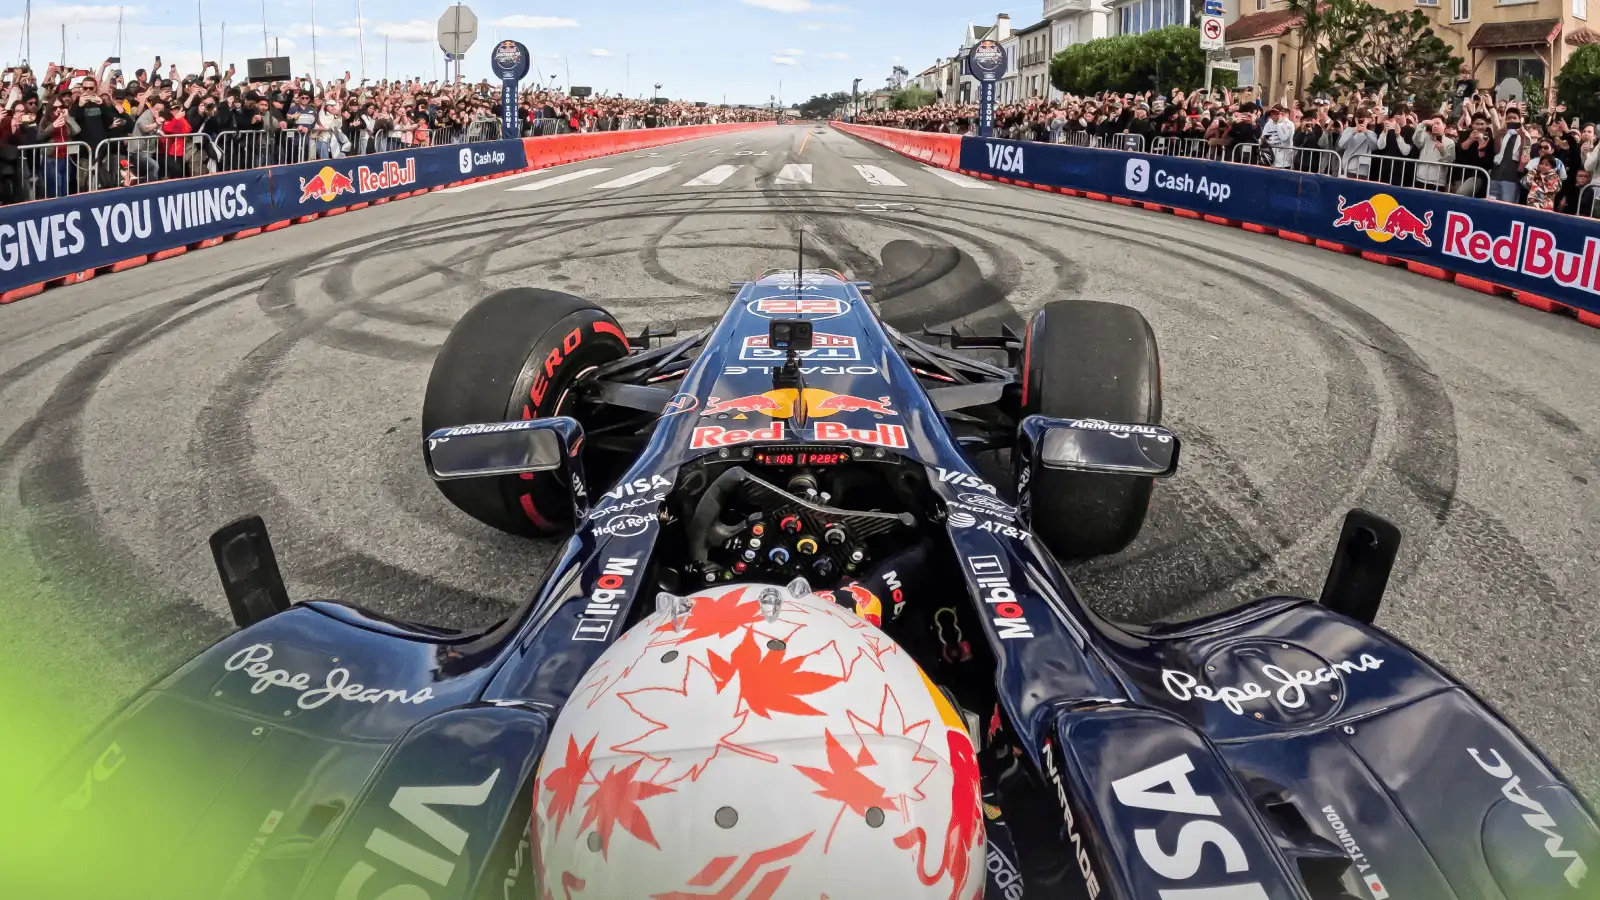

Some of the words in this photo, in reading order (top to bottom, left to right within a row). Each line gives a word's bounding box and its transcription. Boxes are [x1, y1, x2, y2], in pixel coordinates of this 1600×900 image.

[985, 104, 993, 127] ZONE
[473, 151, 492, 166] Cash
[492, 150, 505, 166] App
[985, 142, 1024, 174] VISA
[1155, 169, 1194, 193] Cash
[1196, 176, 1231, 203] App
[0, 210, 85, 271] GIVES
[91, 199, 152, 247] YOU
[723, 366, 878, 375] ORALE
[689, 421, 785, 450] Red
[813, 421, 909, 449] Bull
[599, 474, 673, 500] VISA
[934, 466, 997, 495] VISA
[588, 491, 667, 520] ORACLE
[591, 518, 626, 538] Hard
[625, 512, 660, 529] Rock
[976, 519, 1033, 541] AT&T
[583, 557, 639, 616] Mobil
[881, 569, 907, 620] Mob
[976, 576, 1035, 640] Mobil
[224, 642, 311, 695] Pepe
[296, 667, 435, 710] Jeans
[1161, 668, 1272, 716] Pepe
[1261, 653, 1385, 709] Jeans
[1321, 804, 1372, 874] Y.TSUNODA
